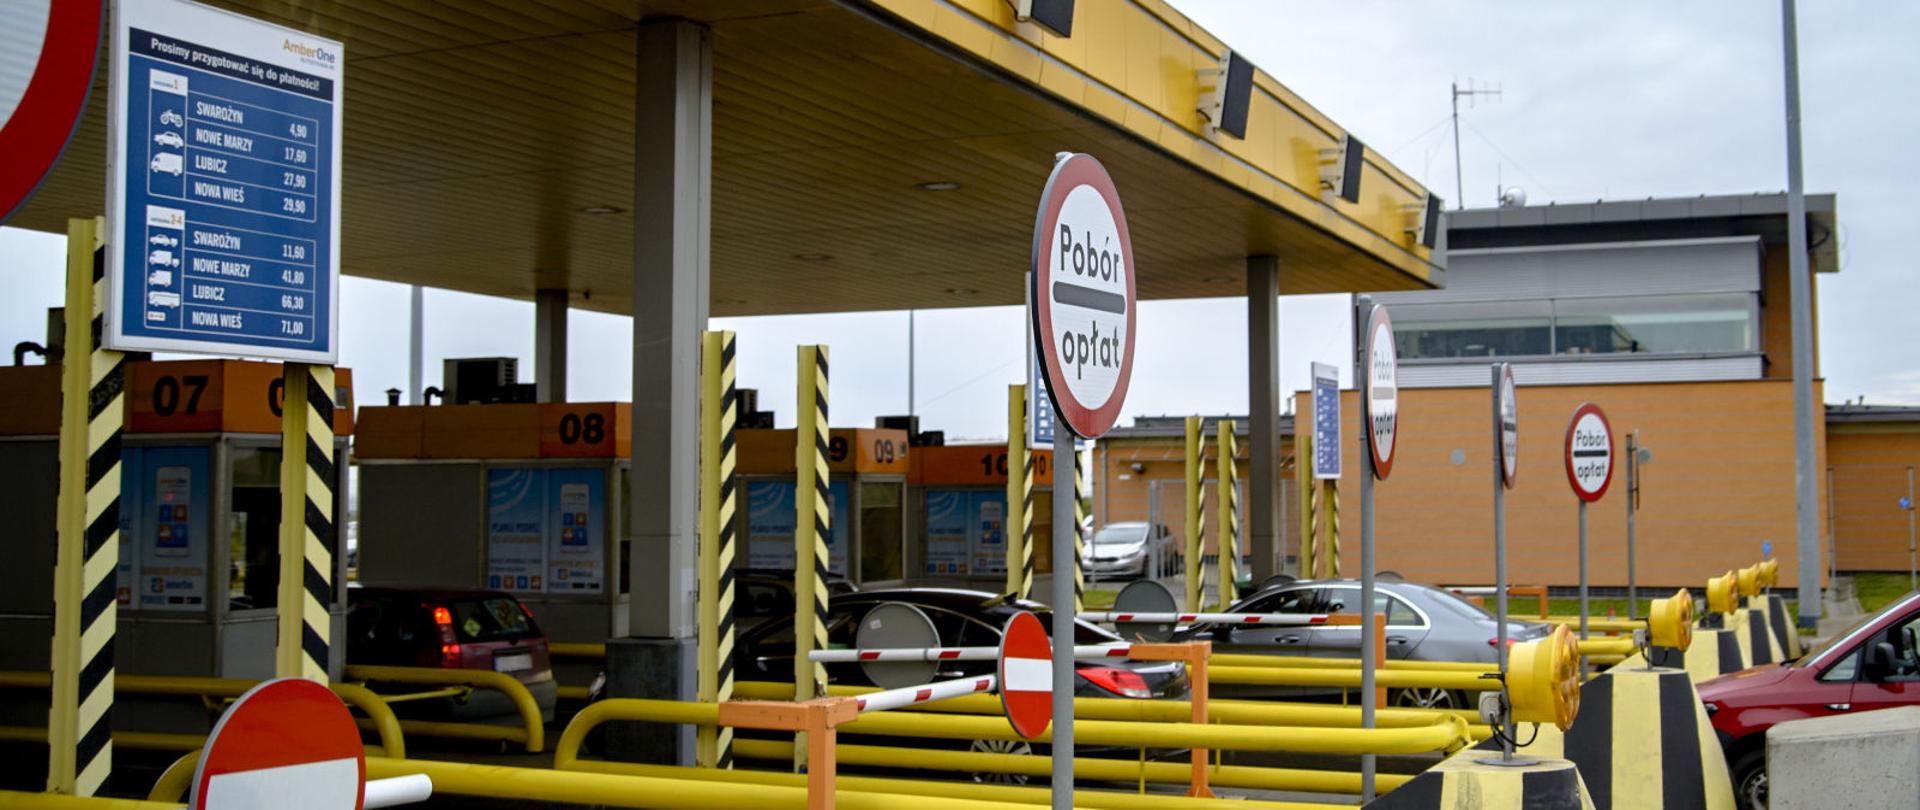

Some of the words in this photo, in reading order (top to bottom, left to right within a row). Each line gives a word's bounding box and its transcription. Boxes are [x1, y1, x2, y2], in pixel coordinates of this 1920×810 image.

[151, 37, 190, 60] Prosimy
[192, 50, 249, 73] przygotować
[251, 65, 264, 80] się
[265, 67, 277, 81] do
[279, 68, 320, 92] płatności!
[282, 38, 335, 64] AmberOne
[196, 101, 243, 124] SWAROŻYN
[289, 123, 307, 138] 4,90
[196, 128, 222, 147] NOWE
[224, 133, 253, 152] MARZY
[285, 147, 307, 163] 17,60
[195, 155, 228, 173] LUBICZ
[283, 172, 306, 188] 27,90
[194, 181, 221, 199] NOWA
[222, 184, 245, 203] WIEŚ
[283, 197, 306, 213] 29,90
[193, 230, 241, 250] SWAROŻYN
[282, 244, 305, 260] 11,60
[1060, 223, 1119, 283] Pobór
[193, 257, 220, 274] NOWE
[221, 262, 251, 278] MARZY
[282, 269, 304, 285] 41,80
[192, 284, 225, 301] LUBICZ
[281, 295, 304, 310] 66,30
[192, 311, 218, 327] NOWA
[219, 312, 243, 329] WIEŚ
[281, 320, 303, 335] 71,00
[1062, 320, 1119, 380] opłat
[153, 376, 208, 416] 07
[560, 412, 604, 444] 08
[874, 439, 894, 464] 09
[1578, 461, 1606, 482] opłat
